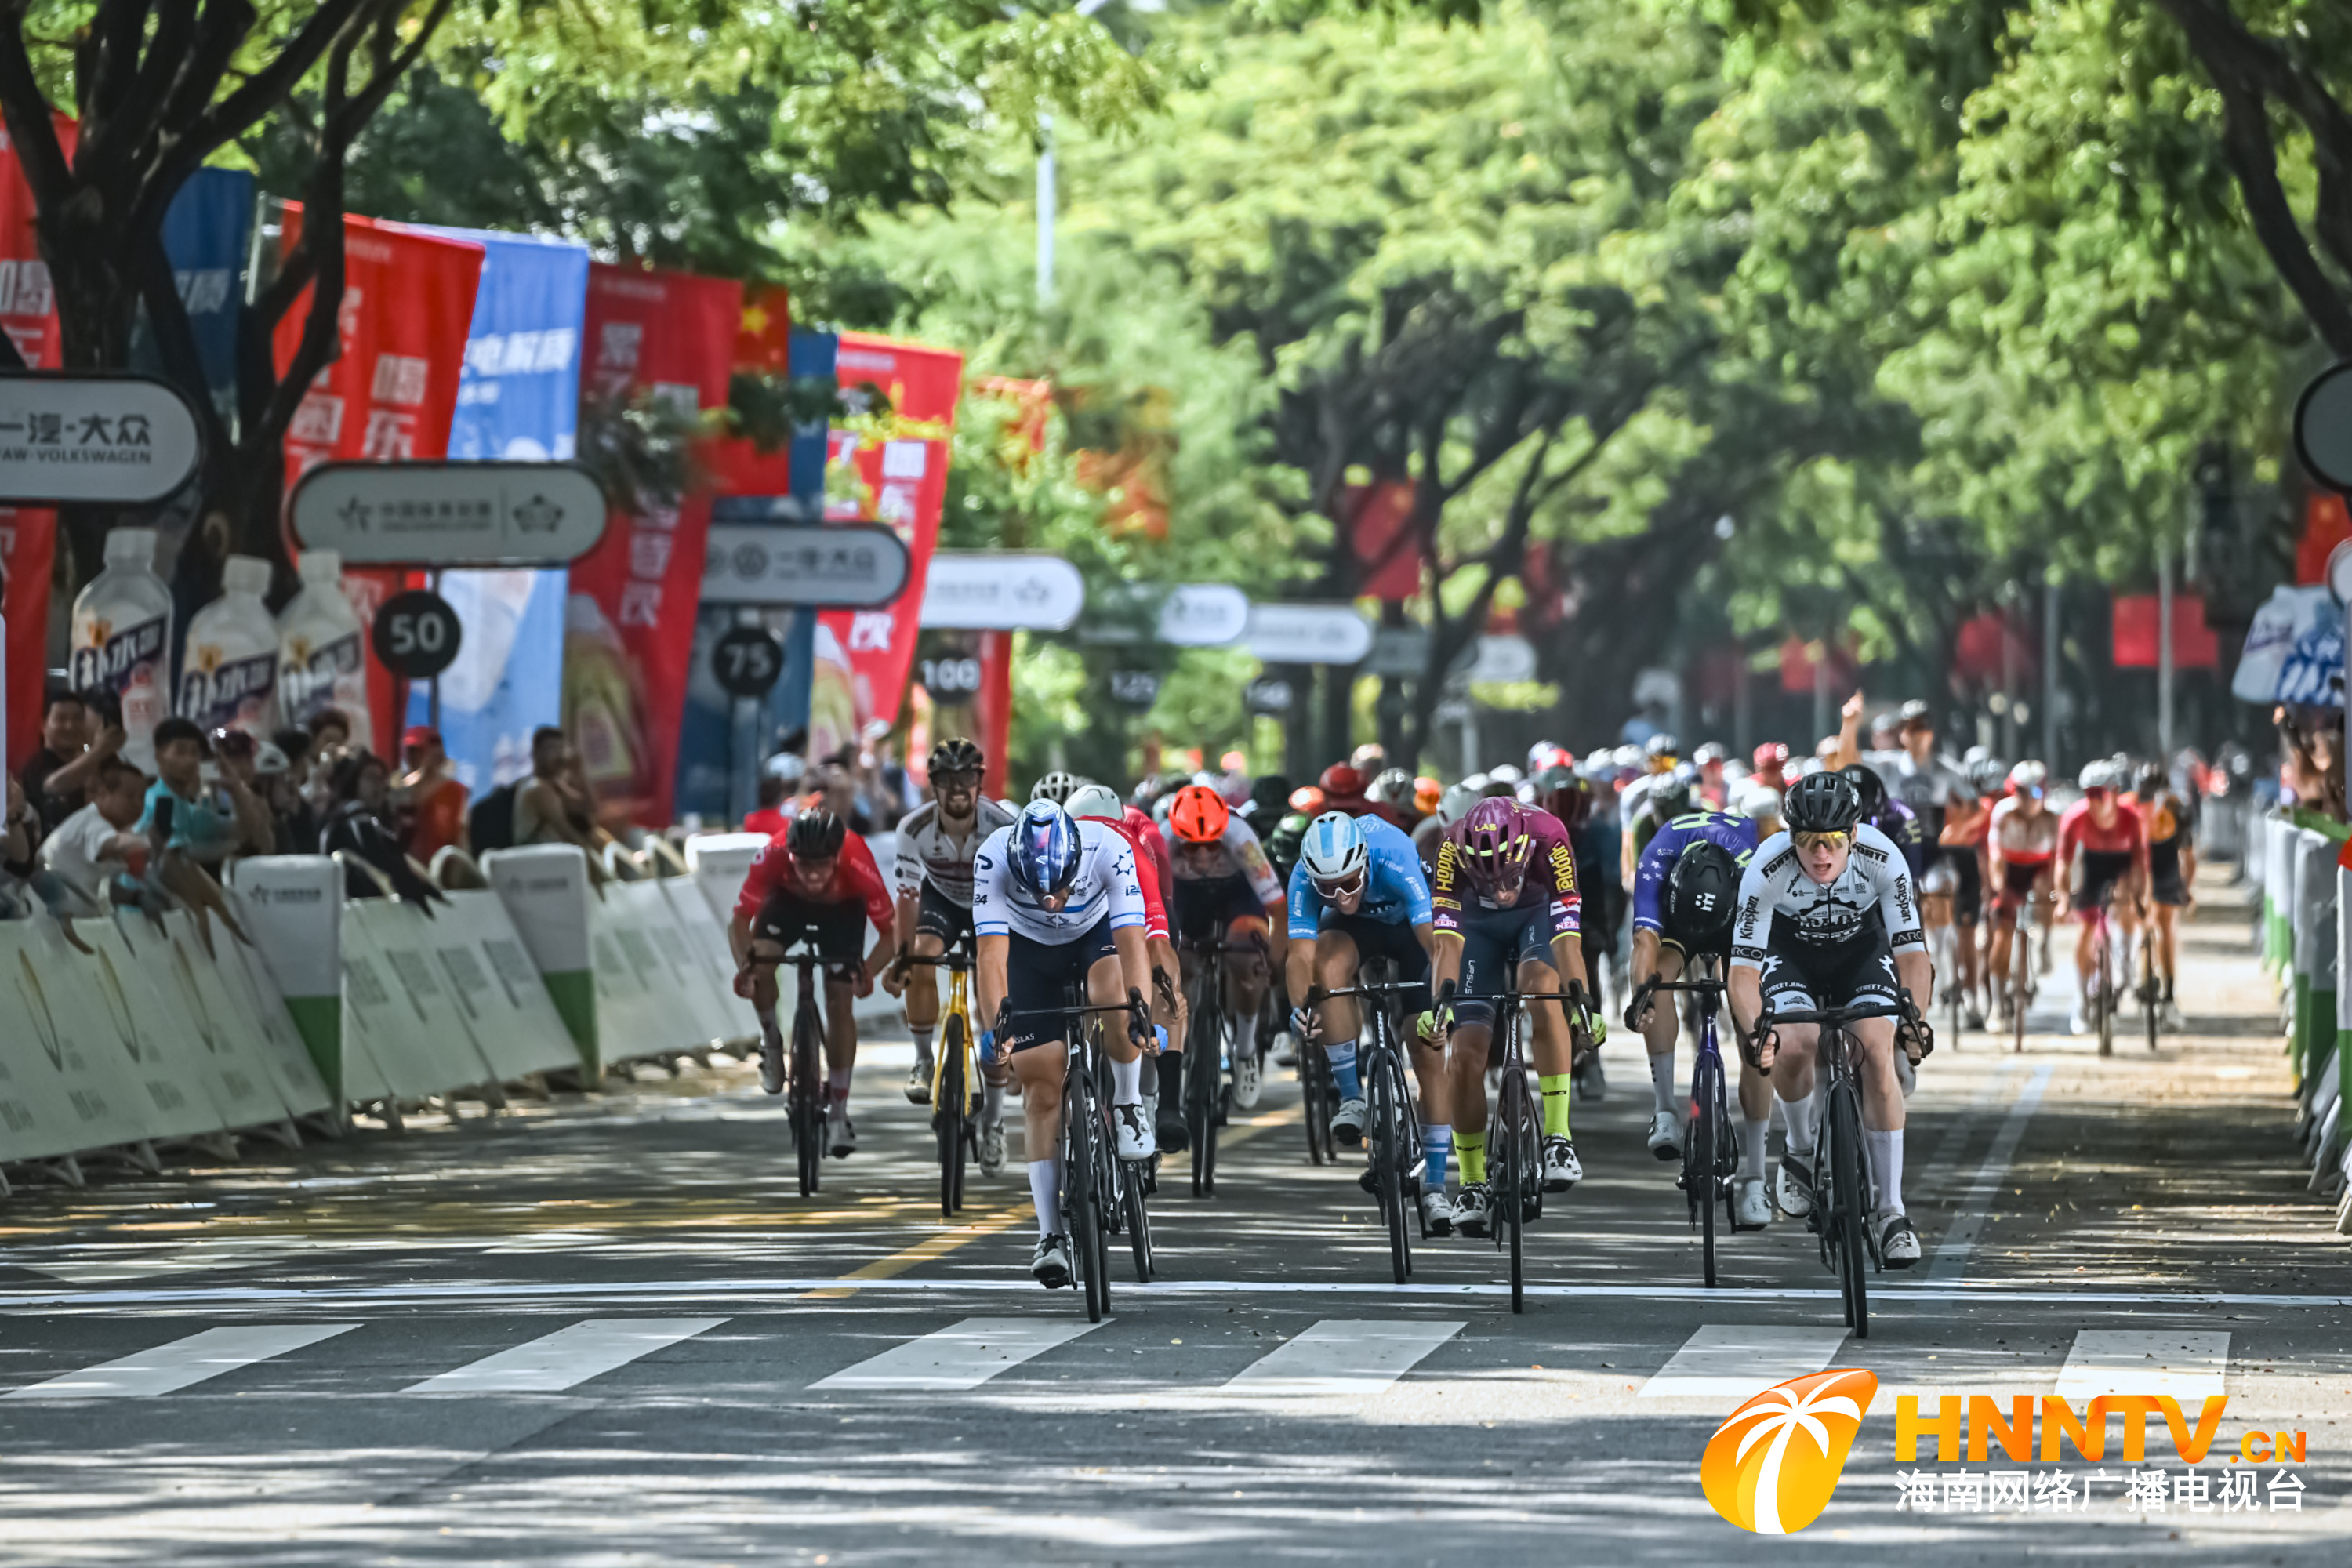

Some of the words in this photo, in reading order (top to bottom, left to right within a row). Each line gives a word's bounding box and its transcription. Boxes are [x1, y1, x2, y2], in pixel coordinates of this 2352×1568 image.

[0, 445, 151, 464] AW-VOLKSWAGEN
[390, 612, 445, 654] 50
[723, 641, 771, 681] 75
[923, 660, 979, 690] 100
[1474, 823, 1497, 832] LAS
[1894, 873, 1912, 924] Kingspan
[1433, 919, 1458, 928] NERI
[1739, 895, 1759, 940] Kingspan
